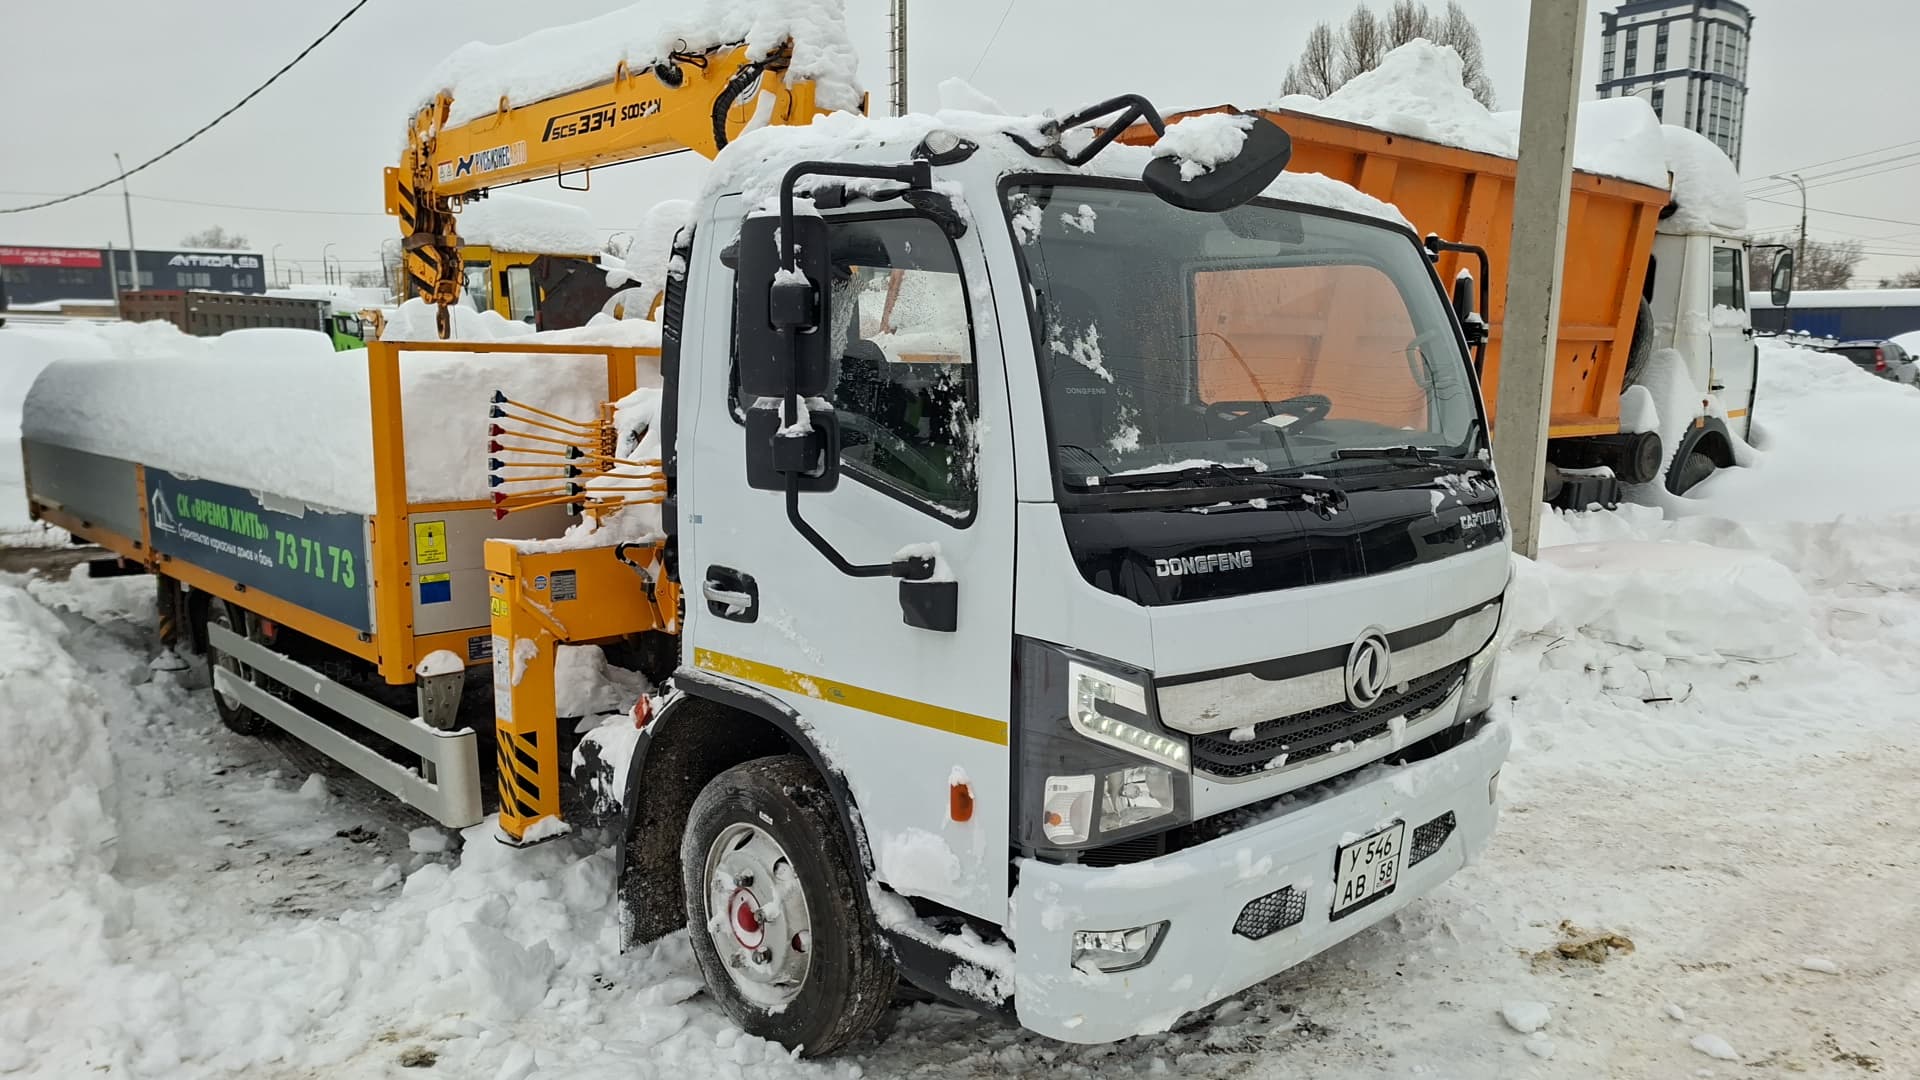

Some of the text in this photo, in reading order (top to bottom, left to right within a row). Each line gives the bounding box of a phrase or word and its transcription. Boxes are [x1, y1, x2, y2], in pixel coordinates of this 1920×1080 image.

[177, 493, 191, 518] СК
[275, 530, 355, 589] 73 71 73
[1155, 550, 1253, 577] DONGFENG
[1351, 833, 1392, 872] У 546
[1342, 860, 1393, 905] АВ 58
